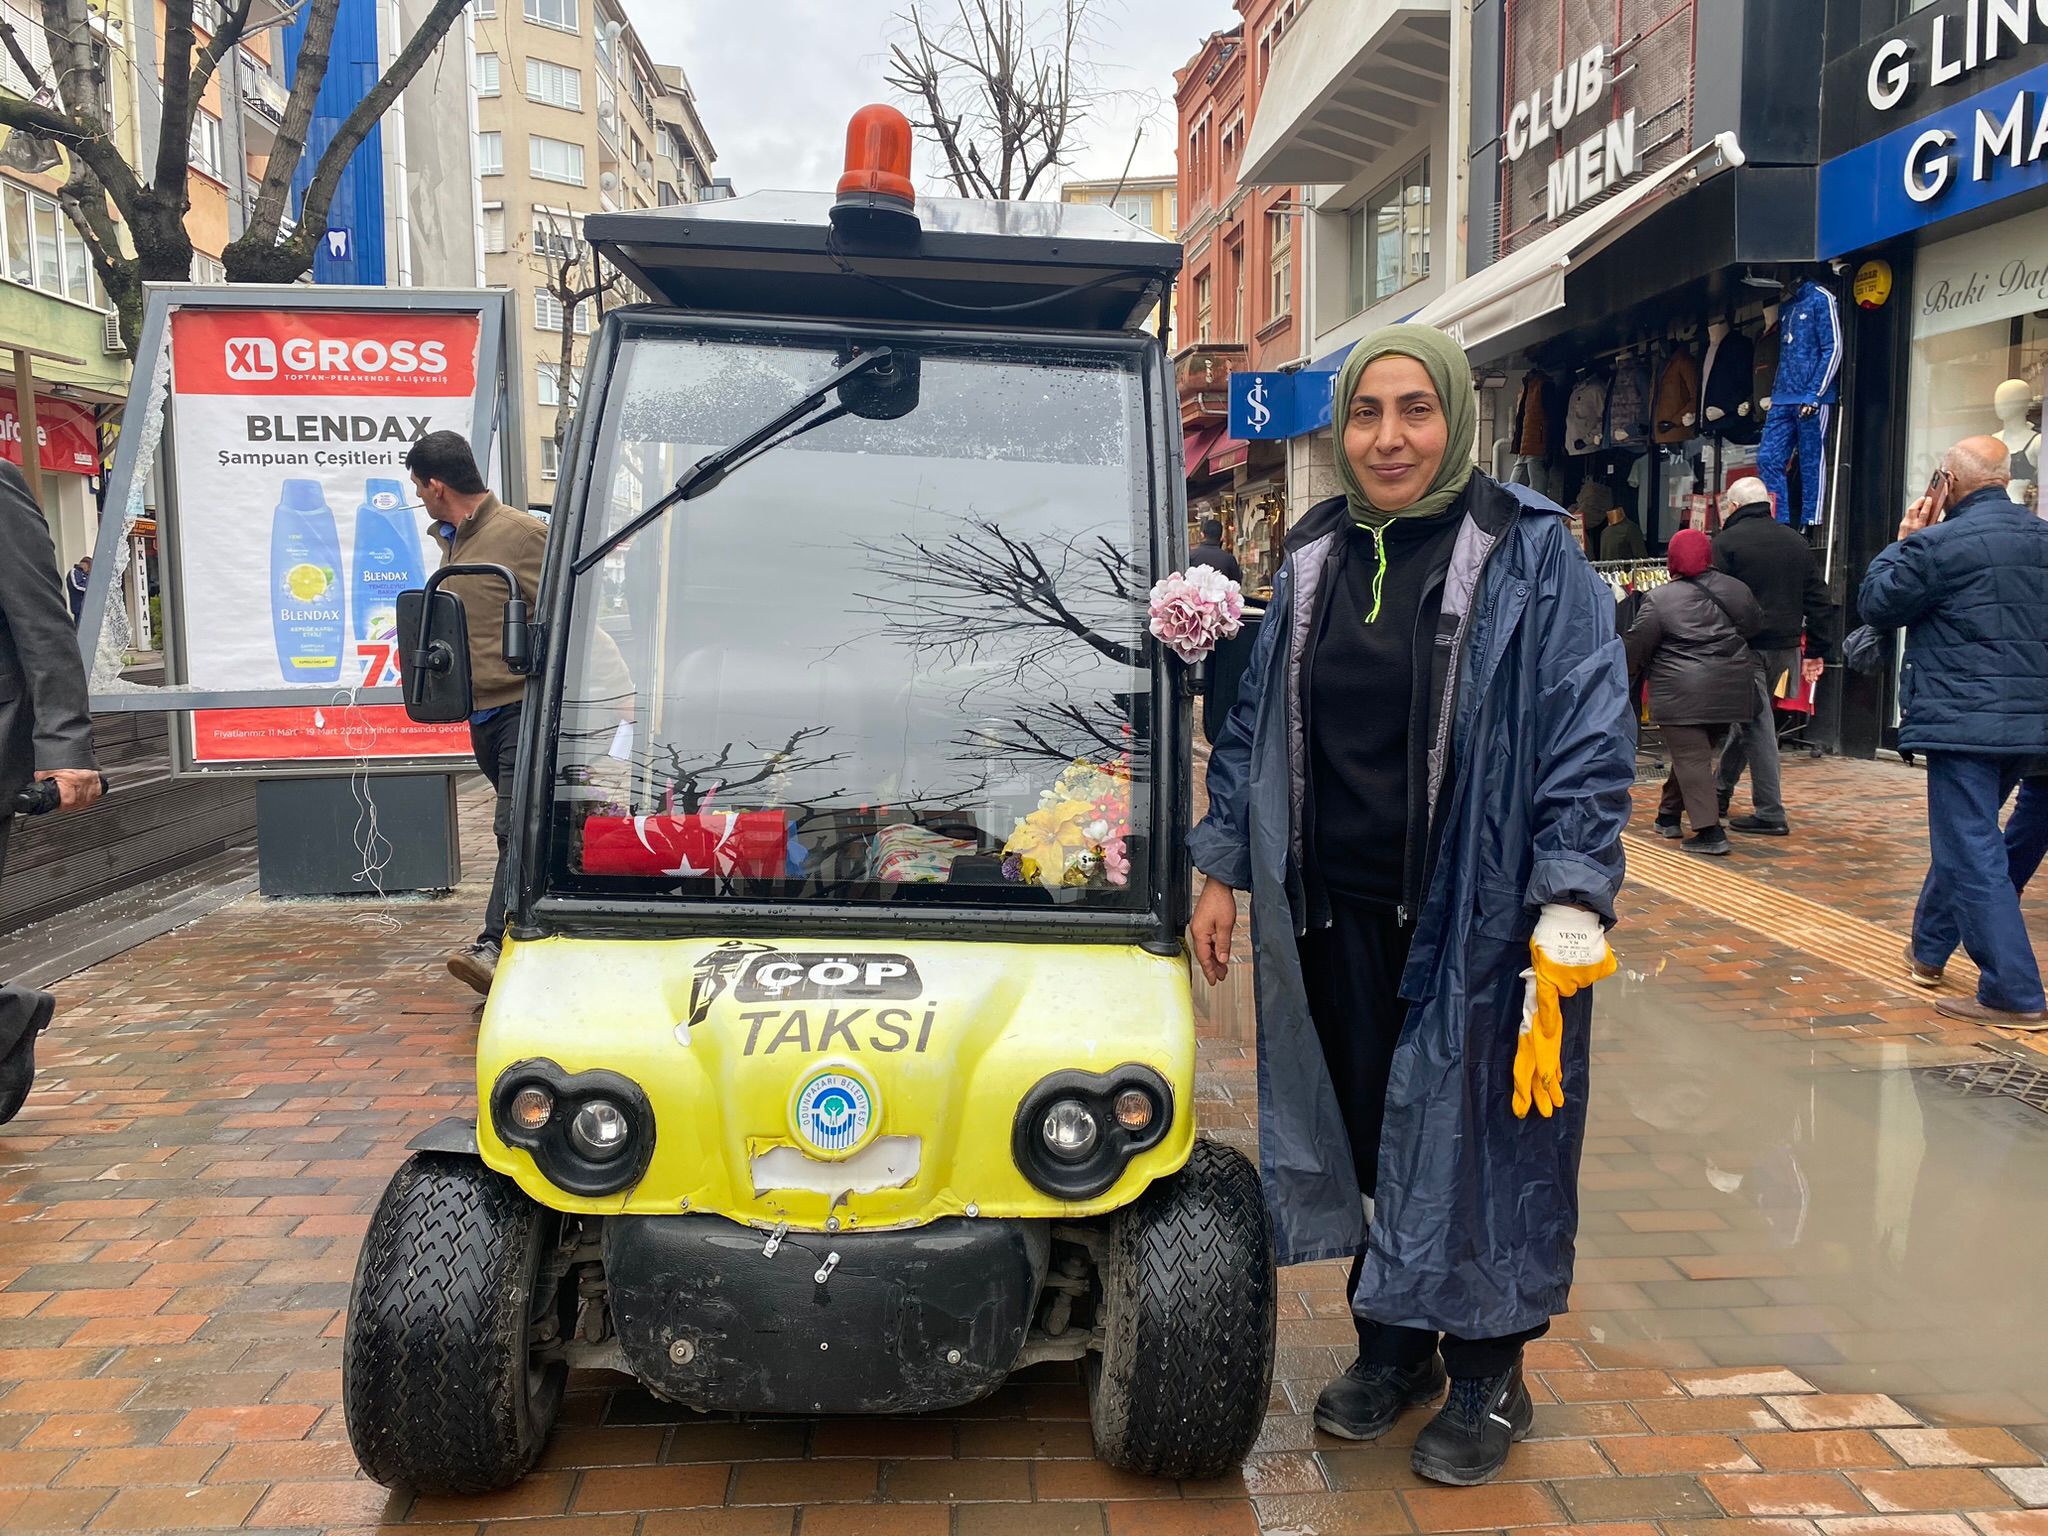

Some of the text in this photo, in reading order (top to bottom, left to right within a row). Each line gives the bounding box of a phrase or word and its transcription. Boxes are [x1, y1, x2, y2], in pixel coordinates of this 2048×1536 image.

[1867, 0, 2048, 111] G LIN
[1507, 43, 1605, 162] CLUB
[1547, 107, 1636, 223] MEN
[1903, 129, 1949, 203] G
[1923, 256, 2048, 316] Baki Dal
[1444, 322, 1465, 345] EN
[229, 338, 448, 374] XL GROSS
[396, 375, 448, 384] ALIŞVERİŞ
[246, 415, 432, 443] BLENDAX
[218, 450, 309, 468] Şampuan
[314, 449, 392, 468] Çeşitleri
[363, 570, 408, 583] BLENDAX
[281, 608, 340, 621] BLENDAX
[213, 729, 266, 739] Fiyatlarımız
[277, 728, 299, 737] Mart
[305, 727, 315, 736] 19
[317, 727, 338, 736] Mart
[340, 726, 363, 735] 2026
[400, 725, 437, 734] arasında
[1559, 932, 1588, 940] VENTO
[755, 958, 908, 996] ÇÖP
[739, 1001, 938, 1056] TAKSİ
[801, 1077, 837, 1126] ODUNPAZARI
